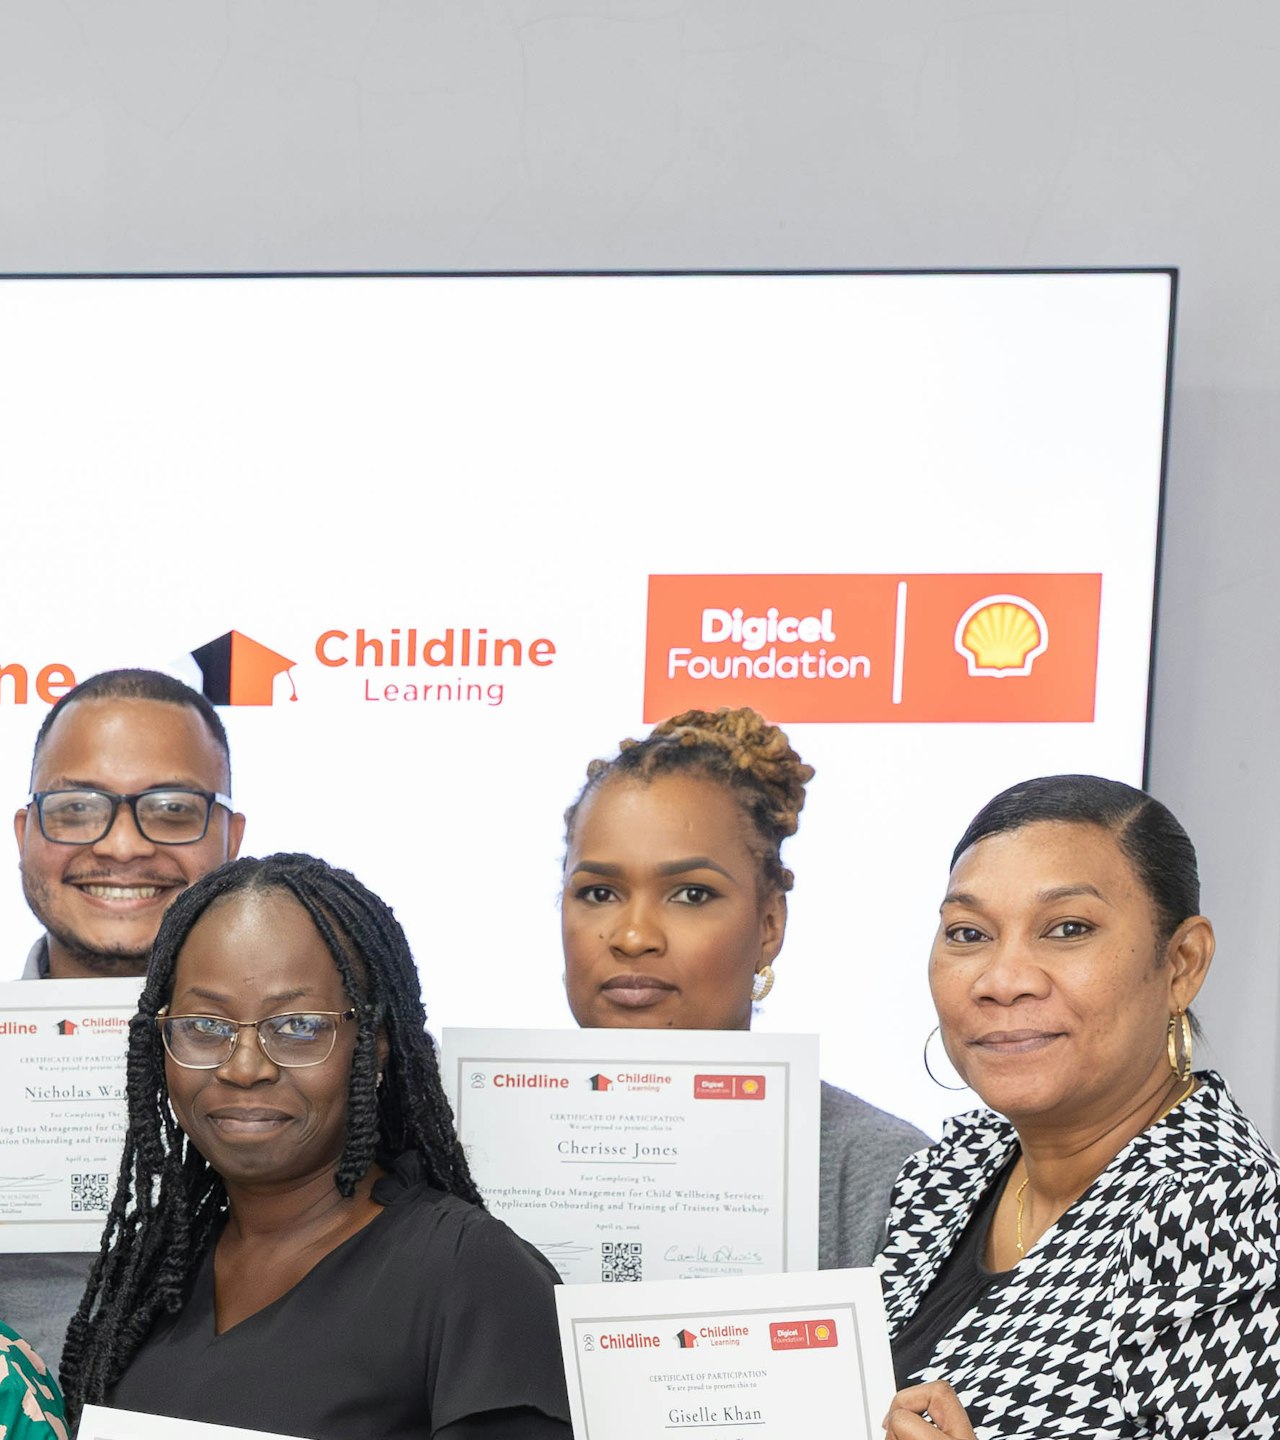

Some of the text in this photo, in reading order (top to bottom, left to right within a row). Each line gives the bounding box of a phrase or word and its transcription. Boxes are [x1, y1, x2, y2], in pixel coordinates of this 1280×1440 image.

[702, 607, 836, 651] Digicel
[315, 628, 557, 668] Childline
[668, 648, 871, 679] Foundation
[364, 678, 505, 707] Learning
[82, 1018, 127, 1027] Childlin
[493, 1073, 569, 1089] Childline
[616, 1073, 672, 1084] Childline
[24, 1085, 91, 1098] Nicholas
[557, 1139, 678, 1160] Cherisse Jones
[699, 1325, 749, 1338] Childline
[777, 1328, 798, 1337] Digicel
[600, 1333, 661, 1350] Childline
[710, 1338, 740, 1347] Learning
[649, 1370, 767, 1383] CERTIFICATE OF PARTICIPATION
[668, 1405, 761, 1424] Giselle Khan
